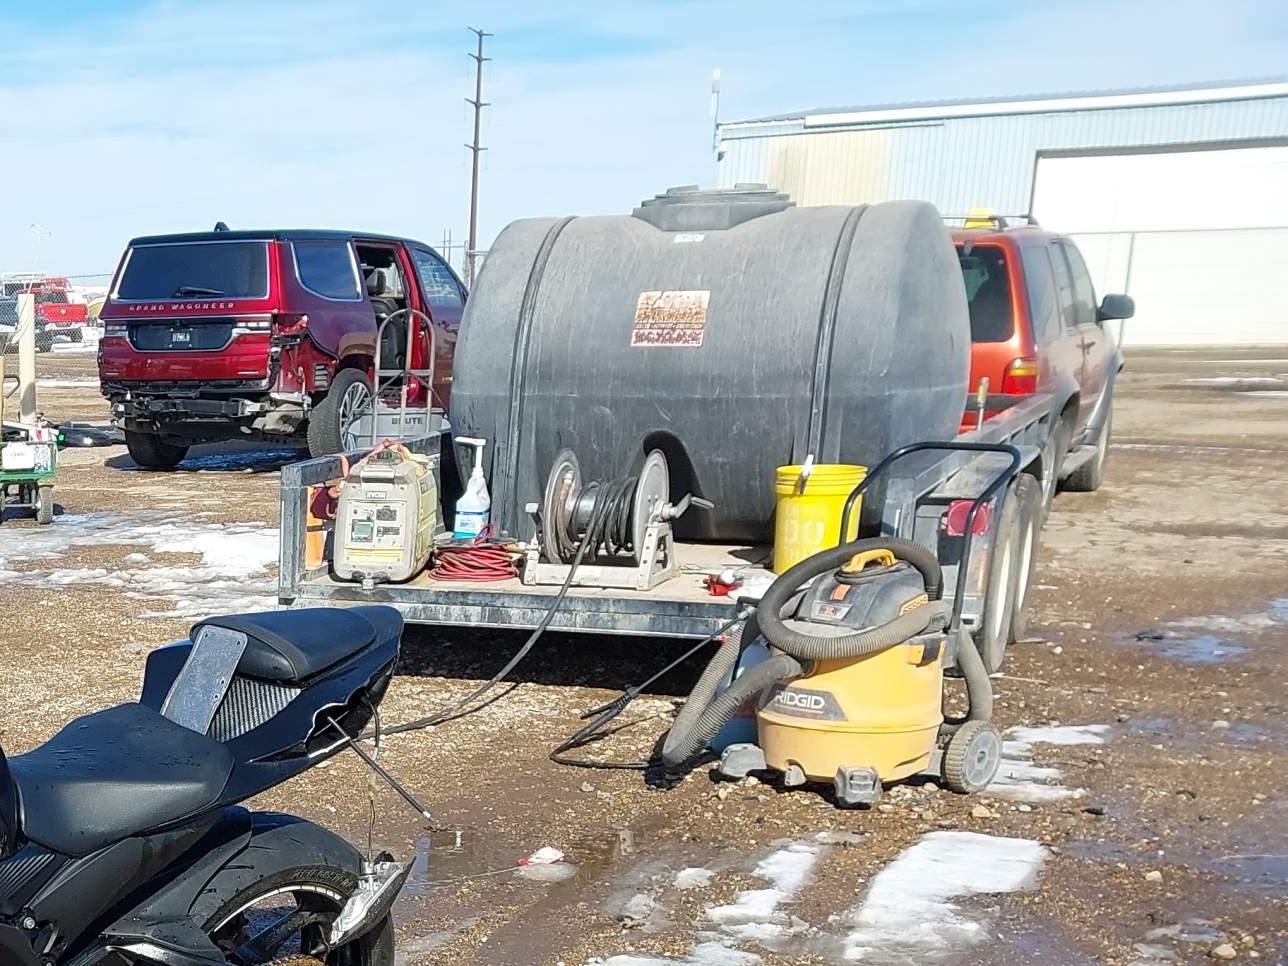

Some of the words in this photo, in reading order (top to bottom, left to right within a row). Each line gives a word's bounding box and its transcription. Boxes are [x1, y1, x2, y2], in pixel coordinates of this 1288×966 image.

[129, 303, 165, 312] GRAND
[171, 302, 235, 311] WAGONEER
[774, 689, 826, 710] RIDGID
